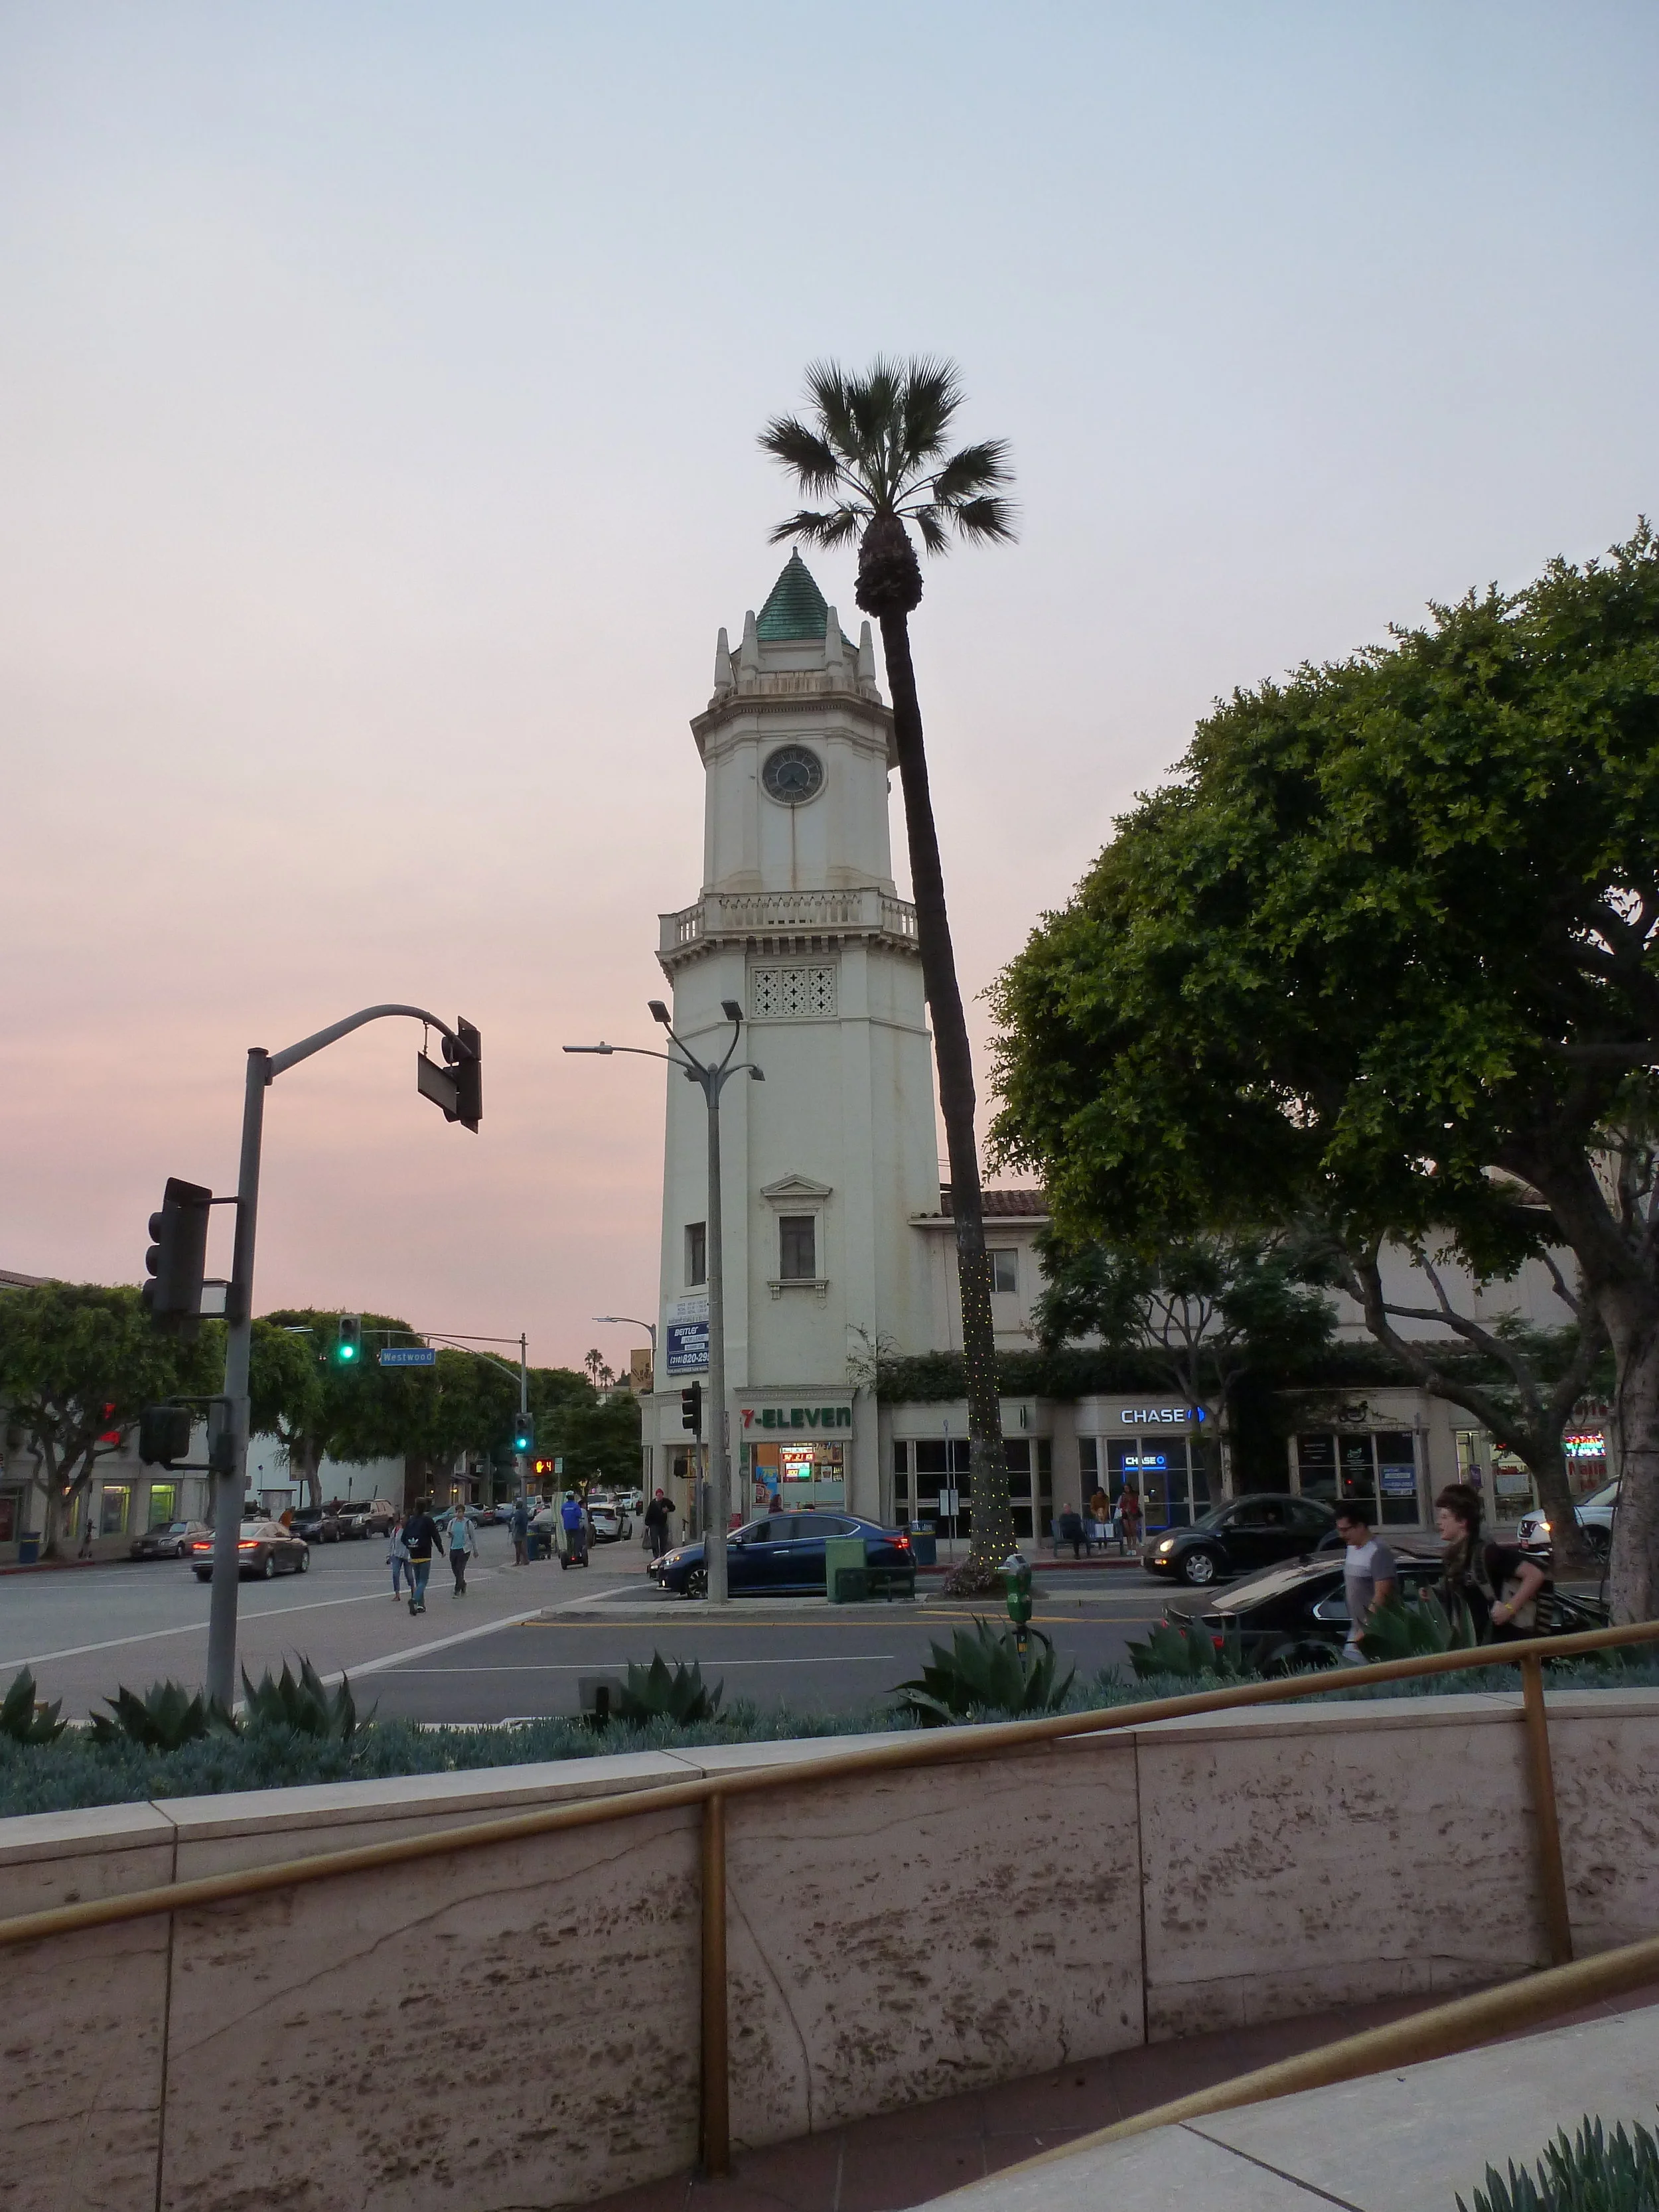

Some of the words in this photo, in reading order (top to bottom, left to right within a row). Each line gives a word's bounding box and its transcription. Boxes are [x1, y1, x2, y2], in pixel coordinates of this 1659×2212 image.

[384, 1353, 432, 1361] Westwood
[1121, 1409, 1185, 1423] CHASE
[546, 1461, 551, 1471] 4
